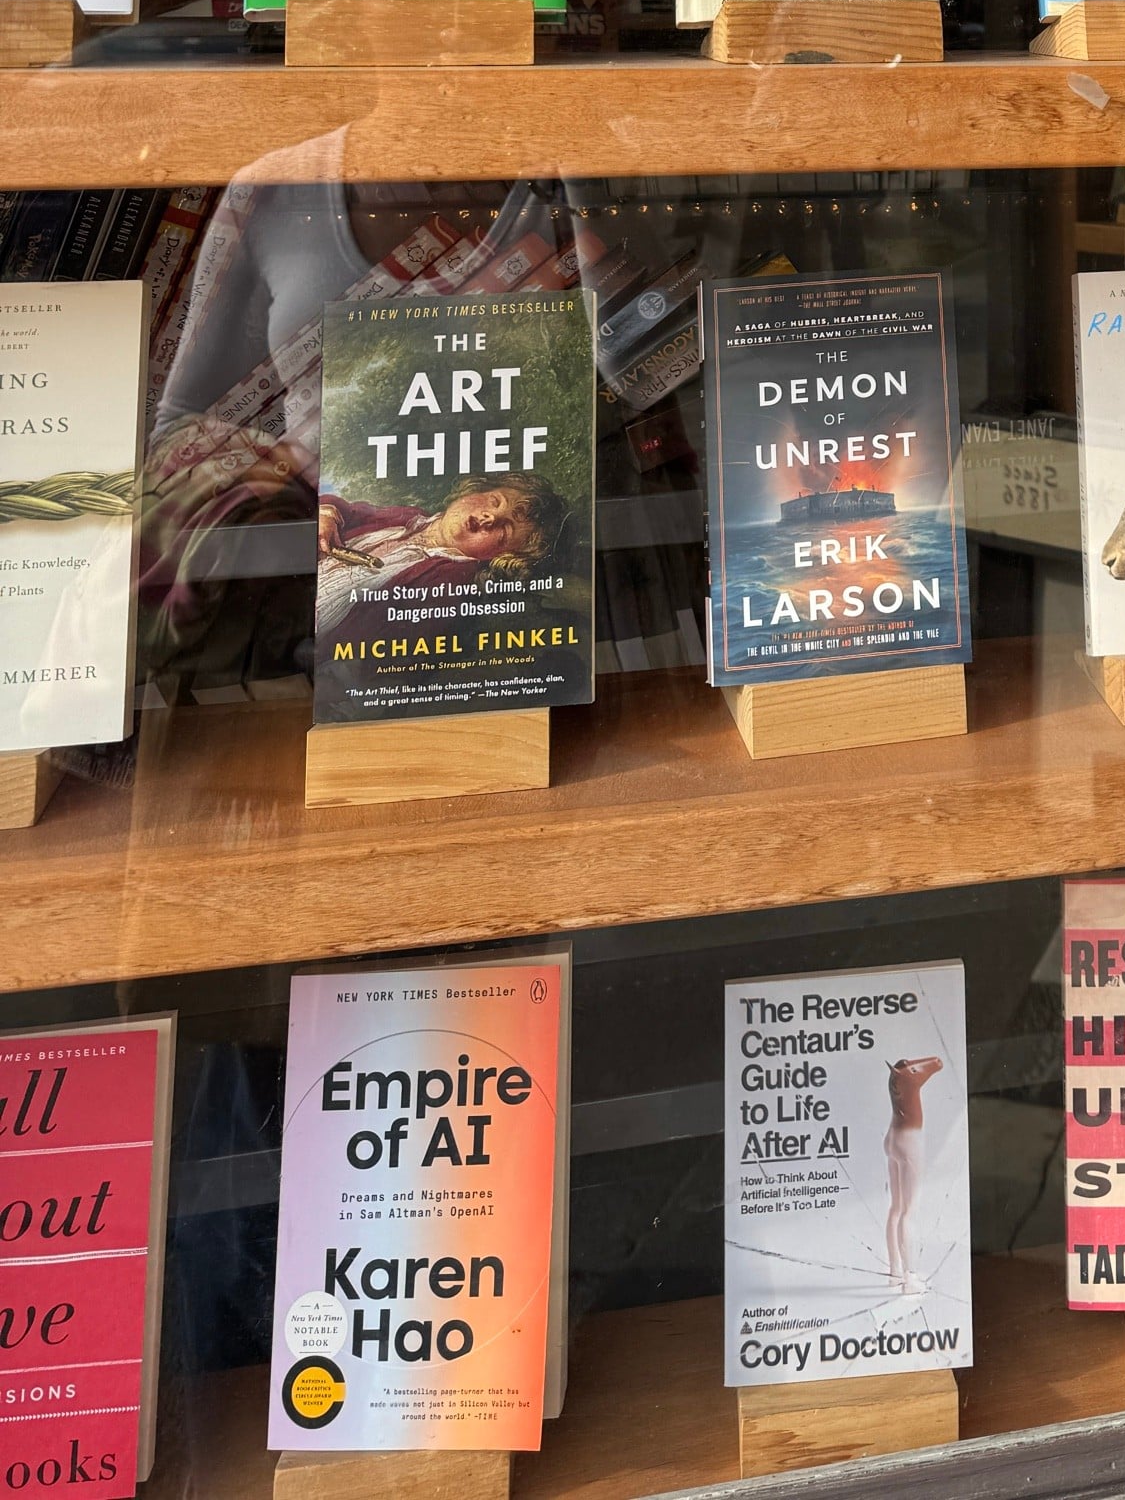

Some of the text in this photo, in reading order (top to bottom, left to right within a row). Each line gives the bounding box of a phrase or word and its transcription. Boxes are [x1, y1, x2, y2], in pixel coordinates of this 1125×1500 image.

[434, 333, 487, 353] THE
[816, 350, 848, 364] THE
[398, 368, 521, 416] ART
[758, 370, 909, 407] DEMON
[823, 412, 846, 426] OF
[367, 426, 548, 478] THIEF
[754, 431, 917, 470] UNREST
[794, 533, 888, 568] ERIK
[350, 578, 564, 603] A True Story of Love, Crime, and a
[742, 577, 941, 627] LARSON
[387, 599, 525, 623] Dangerous Obsession
[333, 626, 579, 661] MICHAEL FINKEL
[740, 991, 918, 1025] The Reverse
[740, 1028, 874, 1058] Centaur's
[322, 1054, 532, 1118] Empire
[741, 1061, 827, 1091] Guide
[740, 1094, 830, 1125] to Life
[346, 1115, 492, 1170] of AI
[740, 1127, 849, 1159] After AI
[323, 1247, 505, 1301] Karen
[351, 1308, 474, 1362] Hao
[740, 1326, 959, 1370] Cory Doctorow
